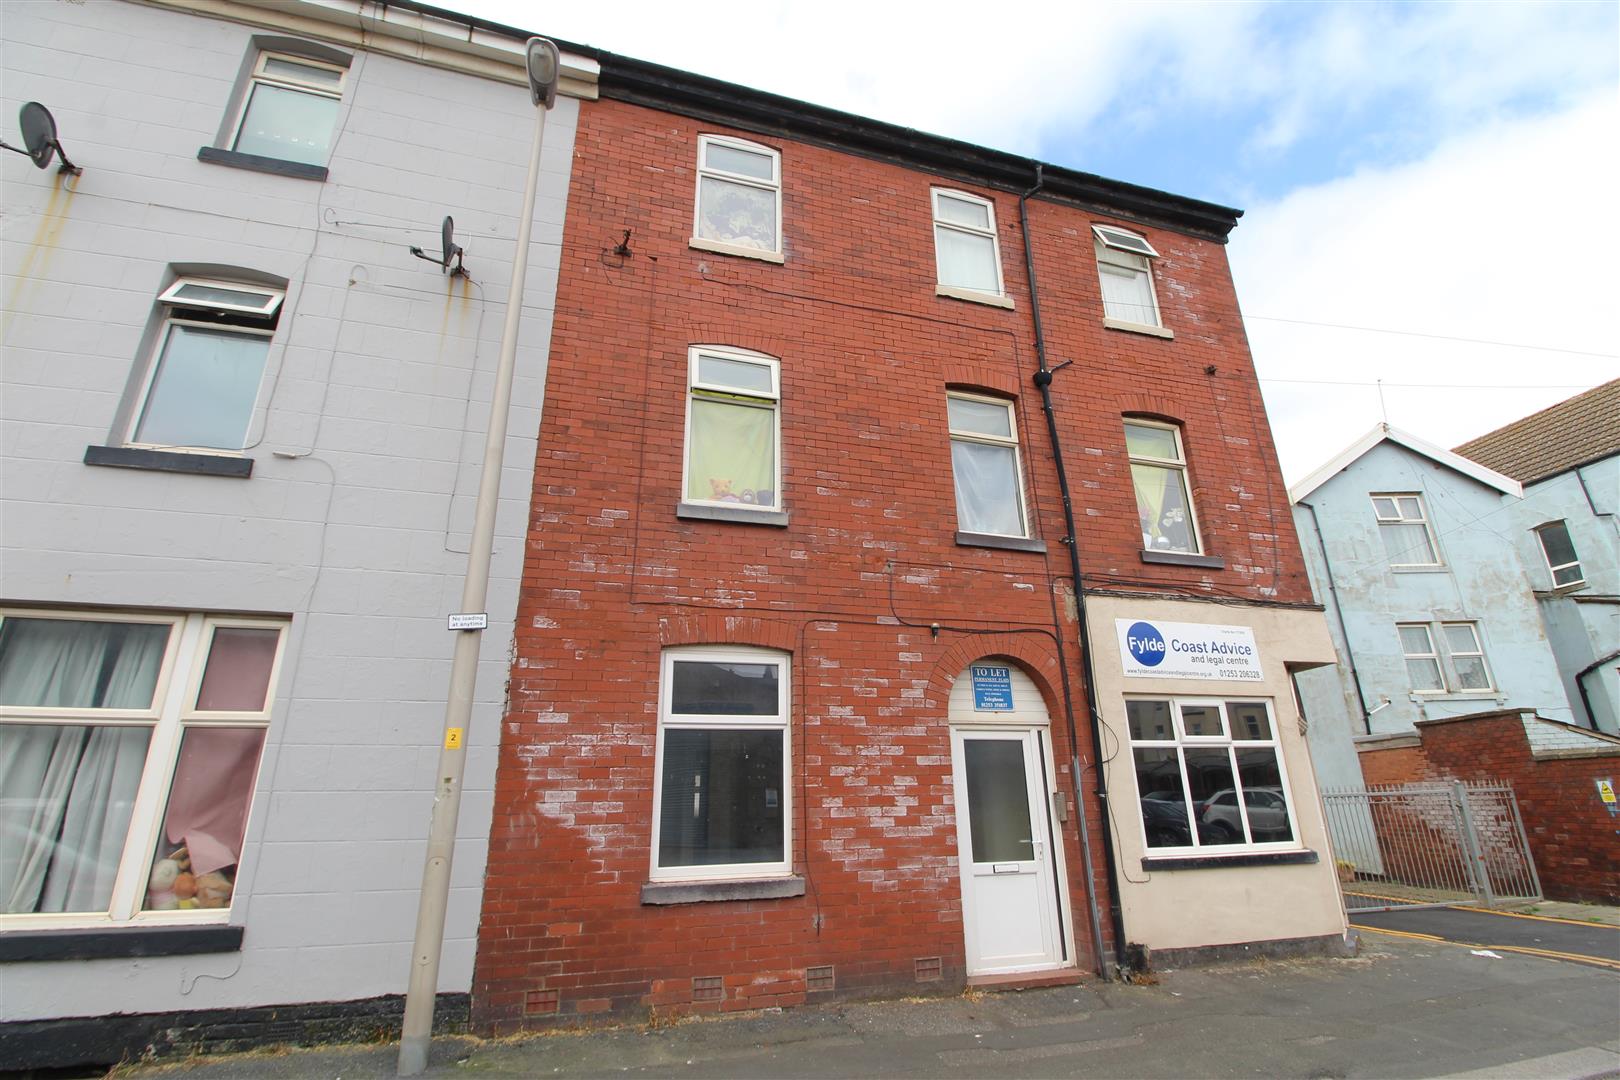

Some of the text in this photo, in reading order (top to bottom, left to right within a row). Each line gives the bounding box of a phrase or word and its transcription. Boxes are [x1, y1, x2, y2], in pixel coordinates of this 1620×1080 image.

[1128, 636, 1252, 656] Fylde Coast Advice
[1191, 654, 1249, 666] and legal centre
[975, 668, 1006, 677] TO LET
[1219, 669, 1238, 677] 01253
